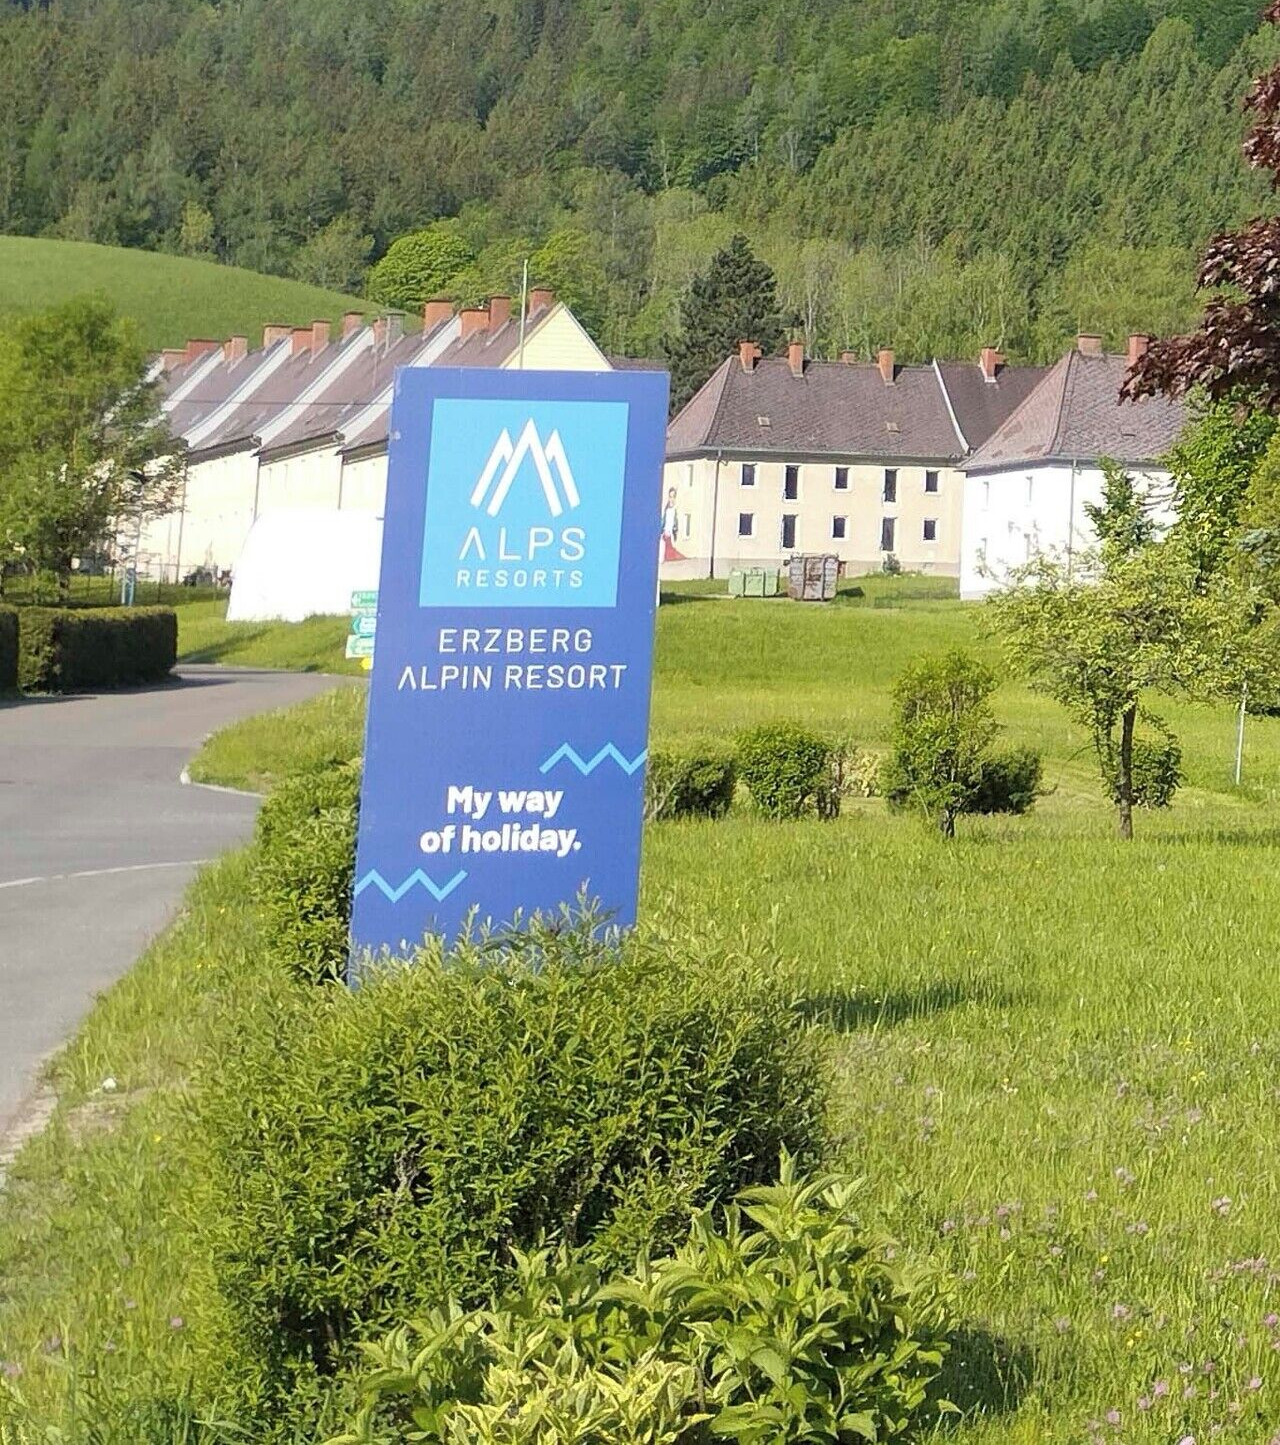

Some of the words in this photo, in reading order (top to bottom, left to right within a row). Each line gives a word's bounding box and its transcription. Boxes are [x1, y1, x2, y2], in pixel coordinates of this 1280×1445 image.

[458, 526, 587, 562] ALPS
[456, 568, 584, 588] RESORTS
[438, 628, 593, 654] ERZBERG
[397, 665, 494, 691] ALPIN
[503, 664, 628, 691] RESORT
[447, 785, 493, 820] My
[498, 790, 564, 819] way
[420, 824, 456, 854] of
[461, 822, 582, 858] holiday.
